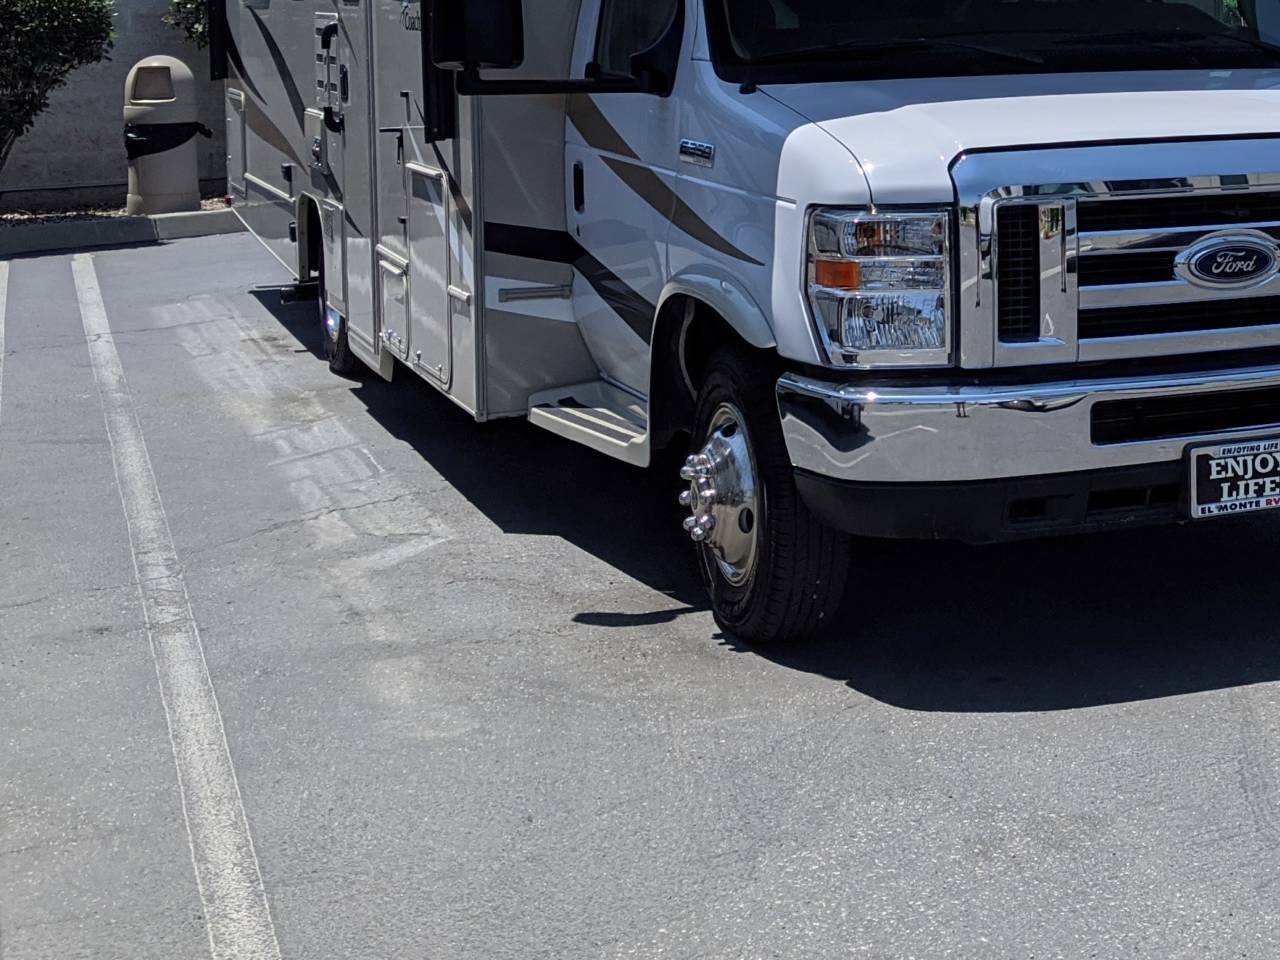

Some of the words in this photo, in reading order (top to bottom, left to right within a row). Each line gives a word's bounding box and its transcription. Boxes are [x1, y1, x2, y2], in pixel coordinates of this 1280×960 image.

[1211, 250, 1257, 274] Ford
[1222, 445, 1261, 456] ENJOYING
[1263, 442, 1279, 451] LIFE
[1220, 476, 1280, 501] LIFE
[1201, 505, 1215, 515] EL
[1216, 500, 1261, 513] MONTE
